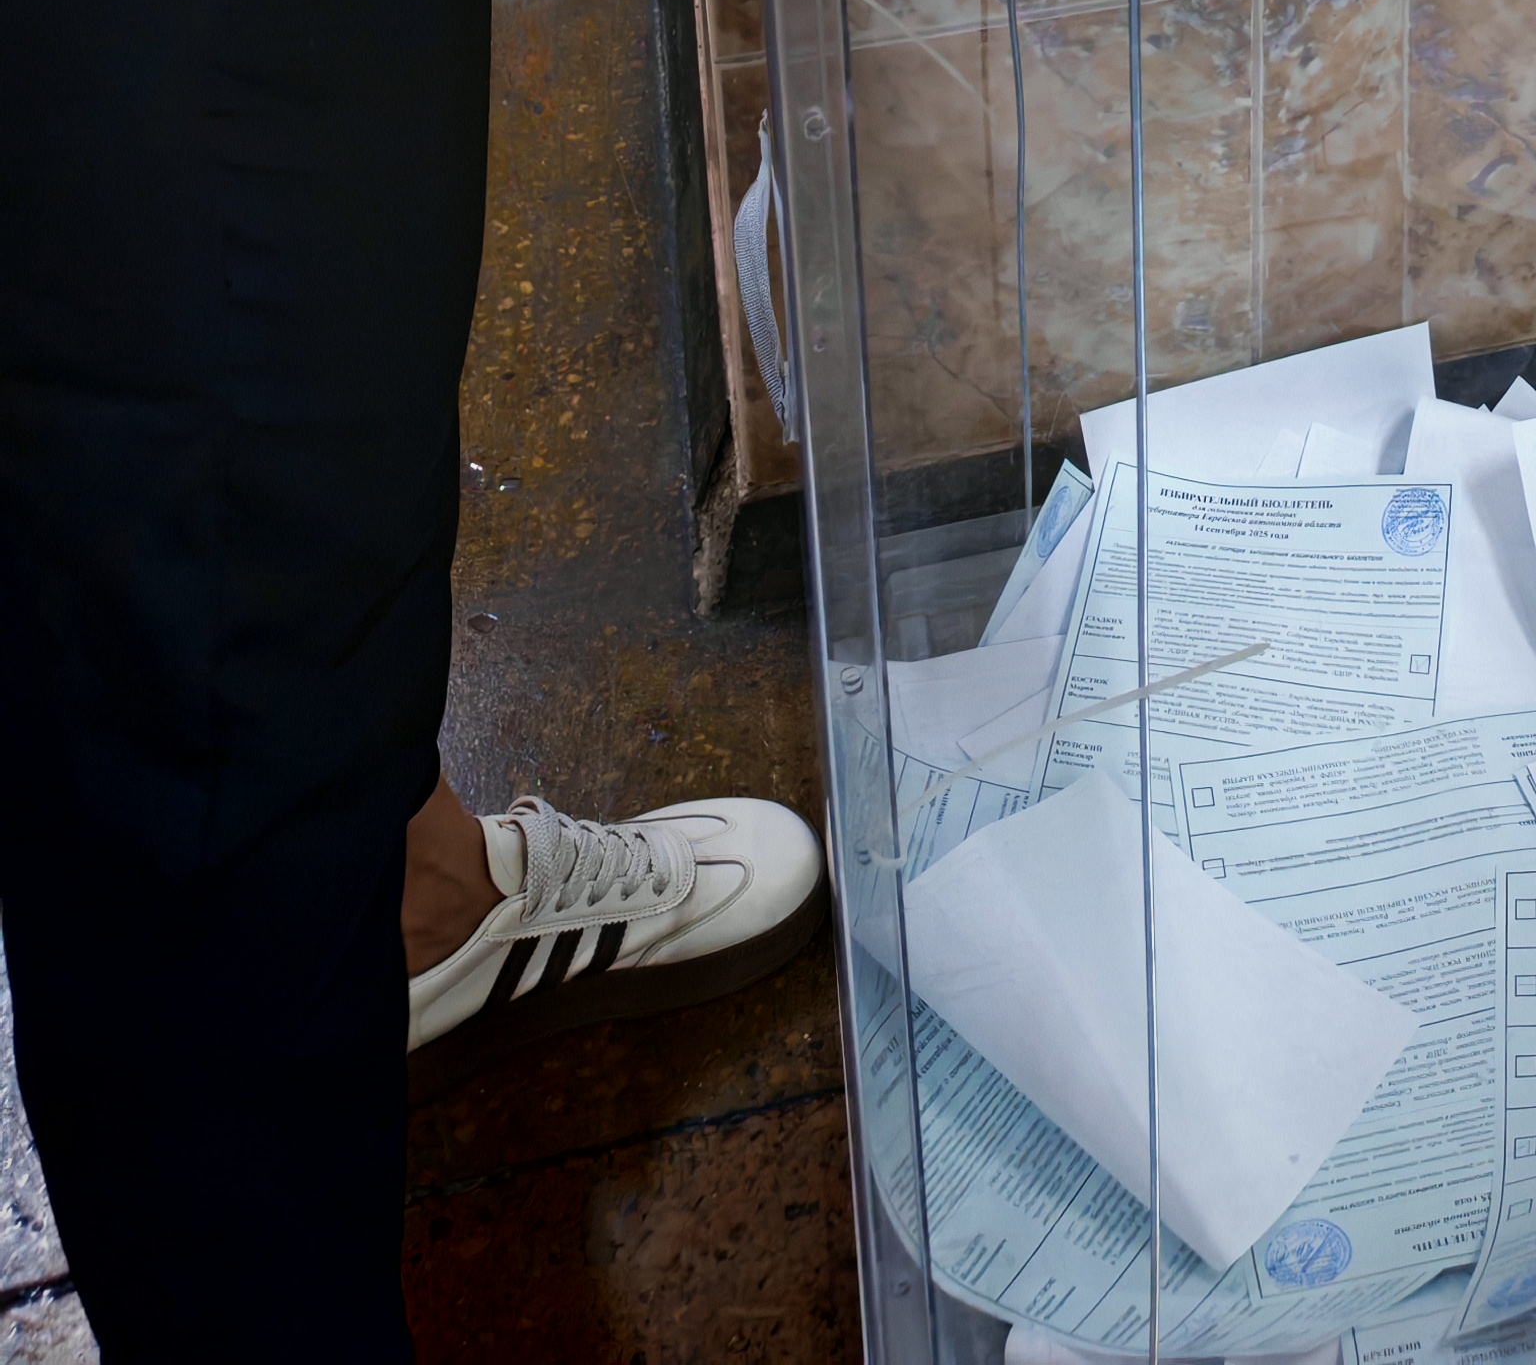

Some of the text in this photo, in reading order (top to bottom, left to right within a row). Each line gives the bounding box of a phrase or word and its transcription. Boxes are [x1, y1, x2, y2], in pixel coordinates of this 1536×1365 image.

[1160, 488, 1334, 510] ИЗБИРАТЕЛЬНЫЙ БЮЛЛЕТЕНЬ
[1148, 506, 1200, 520] убернатора
